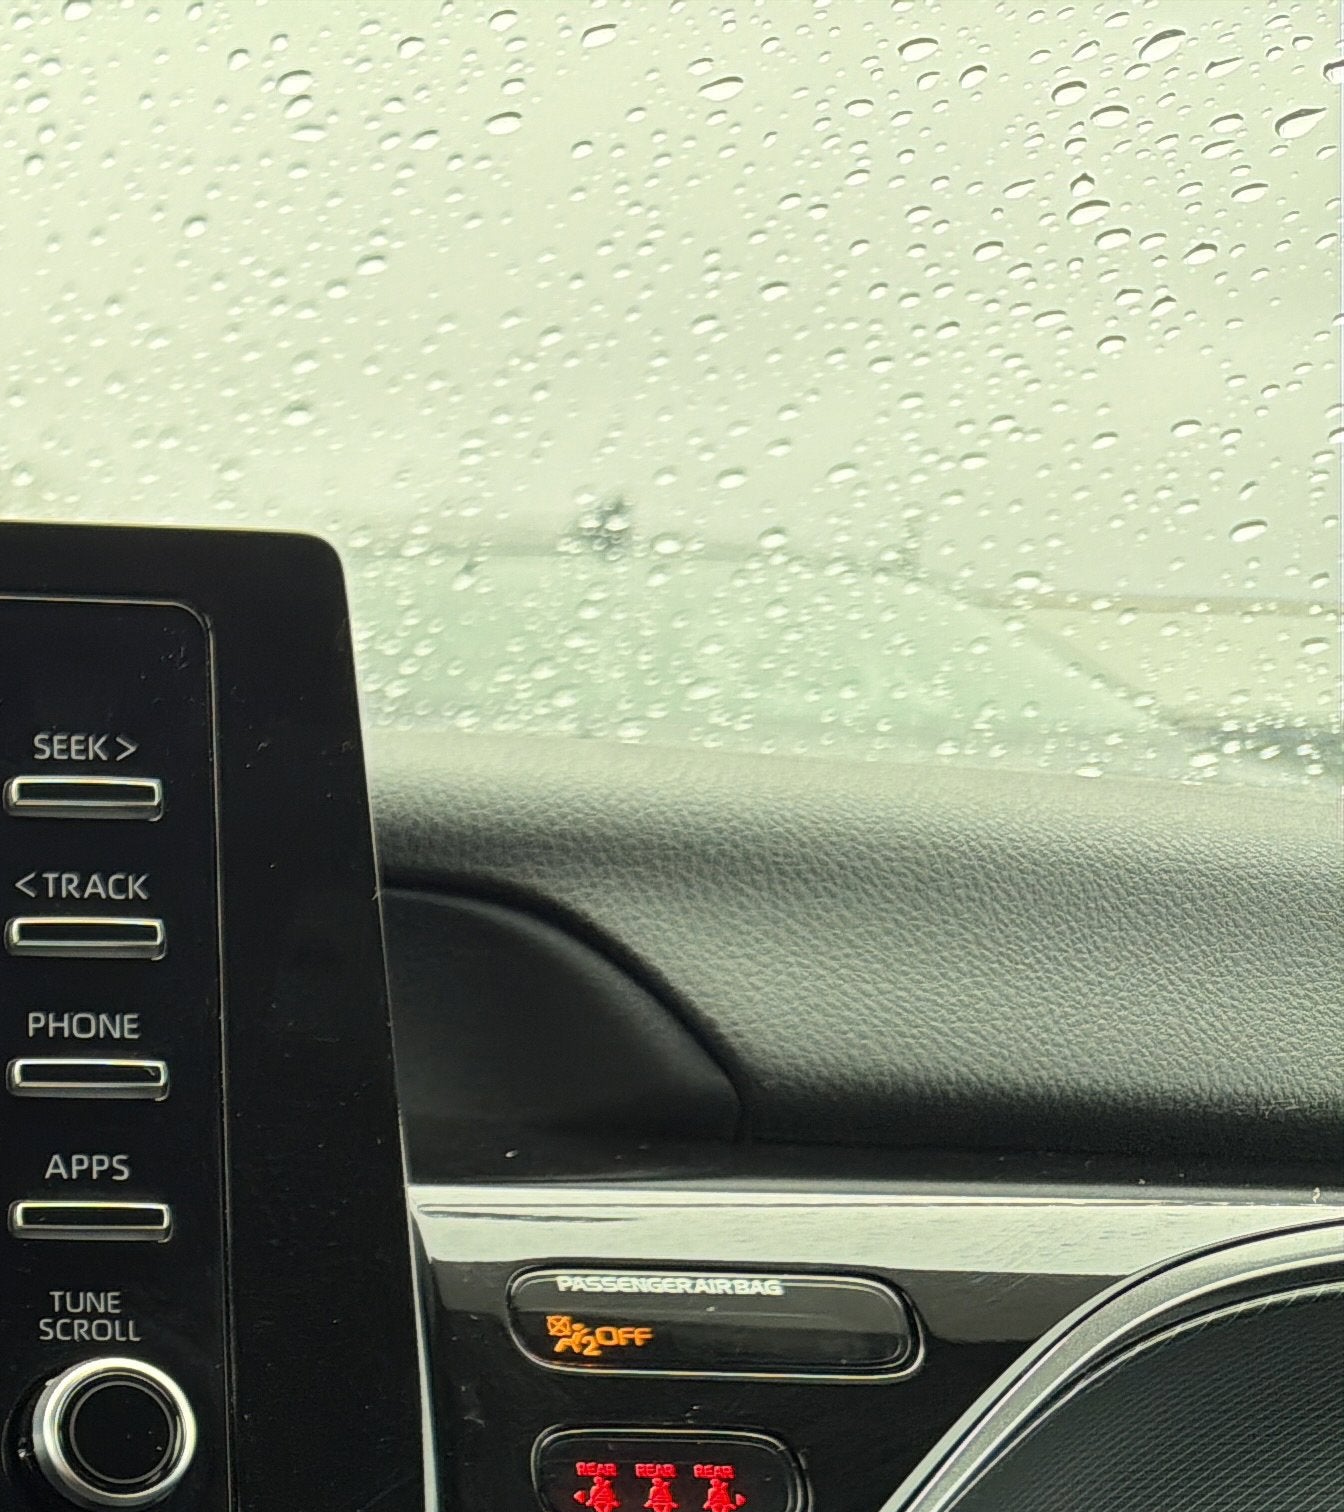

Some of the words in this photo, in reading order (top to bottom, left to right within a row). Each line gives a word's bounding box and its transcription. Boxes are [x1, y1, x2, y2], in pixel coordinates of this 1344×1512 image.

[30, 731, 109, 762] SEEK
[41, 870, 150, 901] TRACK
[26, 1010, 142, 1041] PHONE
[42, 1152, 130, 1184] APPS
[555, 1275, 695, 1293] PASSENGER
[50, 1290, 122, 1315] TUNE
[38, 1316, 142, 1344] SCROLL
[596, 1326, 655, 1347] OFF
[575, 1462, 618, 1477] REAR
[634, 1463, 677, 1478] REAR
[692, 1464, 735, 1479] REAR
